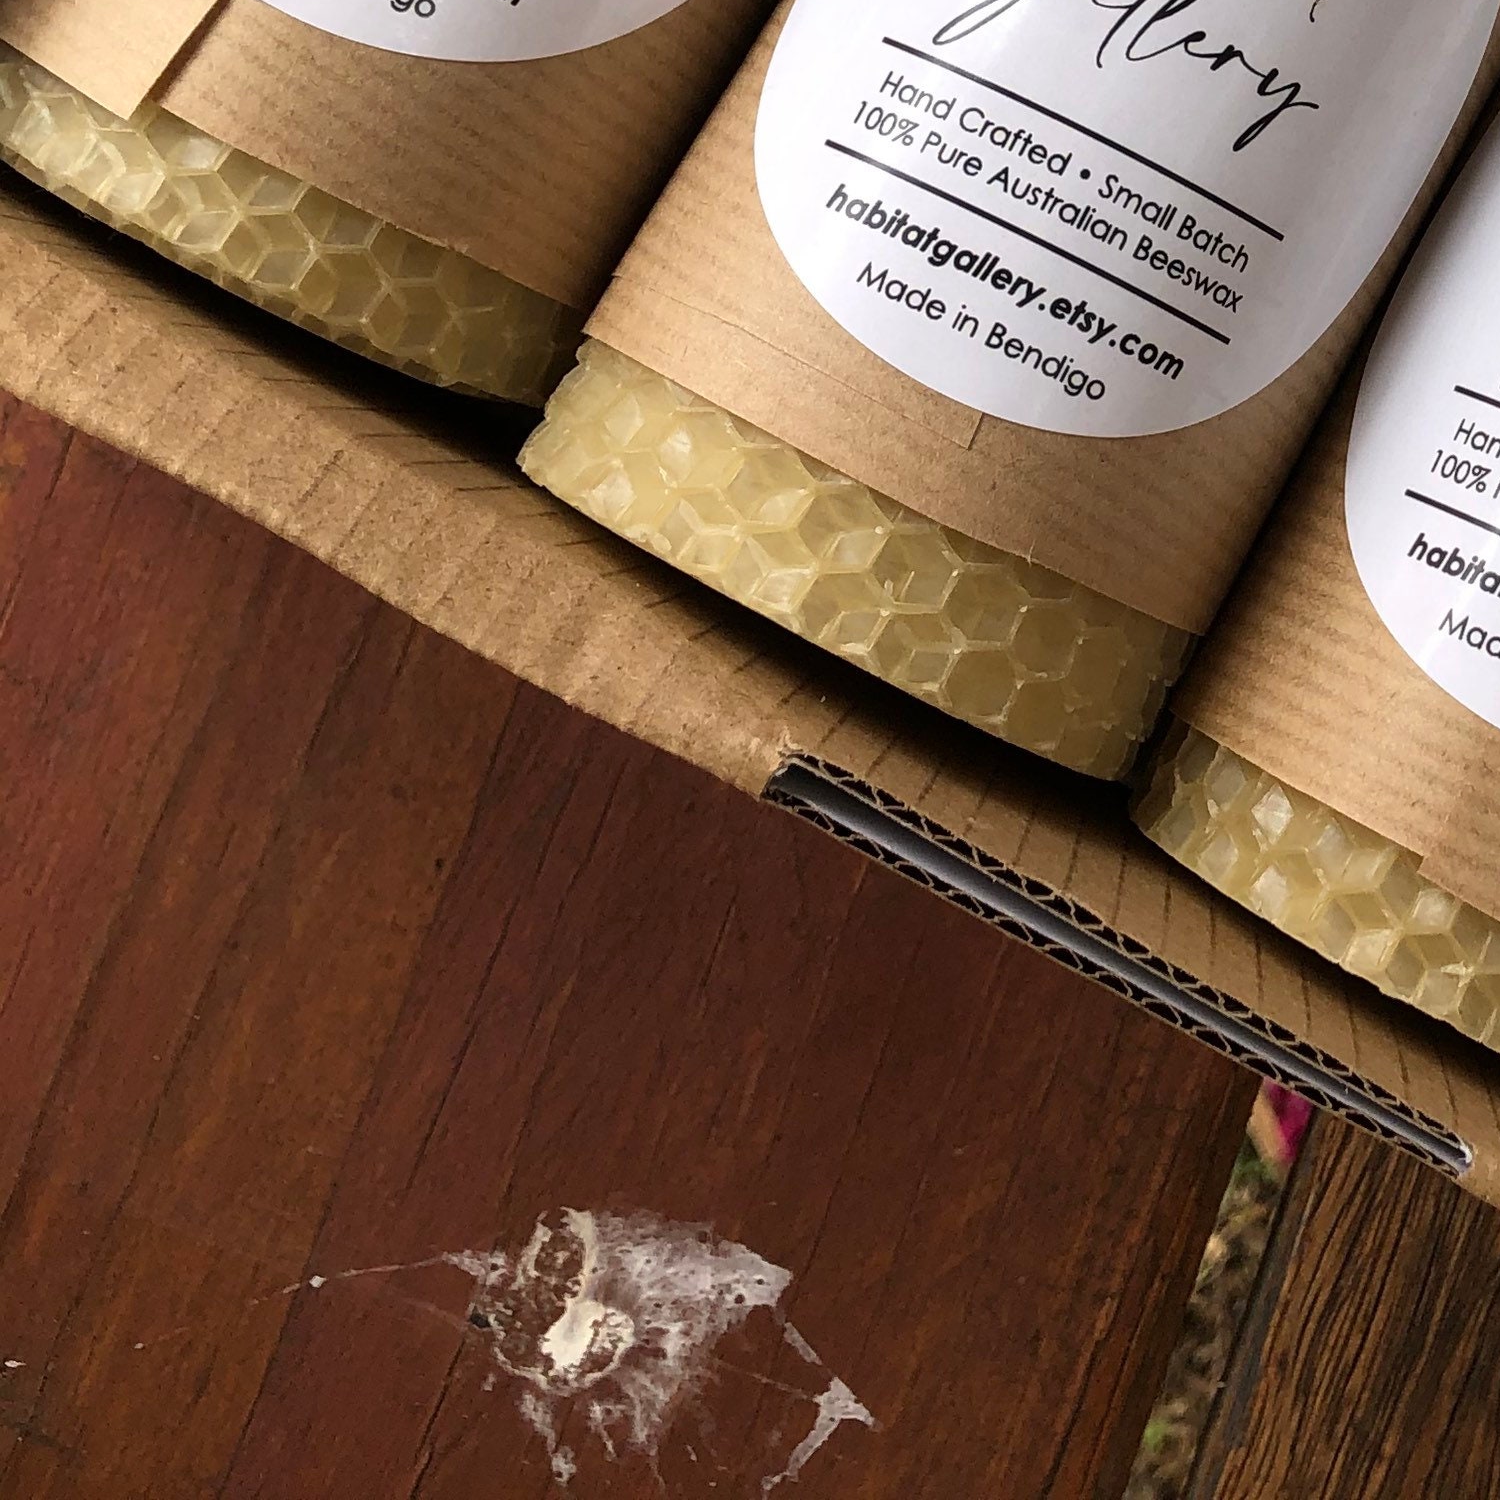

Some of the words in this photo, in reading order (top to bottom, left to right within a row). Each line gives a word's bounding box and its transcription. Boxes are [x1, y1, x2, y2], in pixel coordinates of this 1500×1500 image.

[851, 100, 917, 146] 100%
[921, 131, 985, 177] Pure
[986, 166, 1128, 246] Australian
[1132, 235, 1245, 314] Beeswax
[879, 71, 957, 122] Hand
[959, 107, 1071, 177] Crafted
[1097, 174, 1177, 233] Small
[1178, 216, 1251, 273] Batch
[825, 183, 1185, 381] habitatgallery.etsy.com
[856, 261, 947, 322] Made
[951, 302, 980, 338] in
[984, 315, 1107, 403] Bendigo
[1429, 449, 1489, 493] 100%
